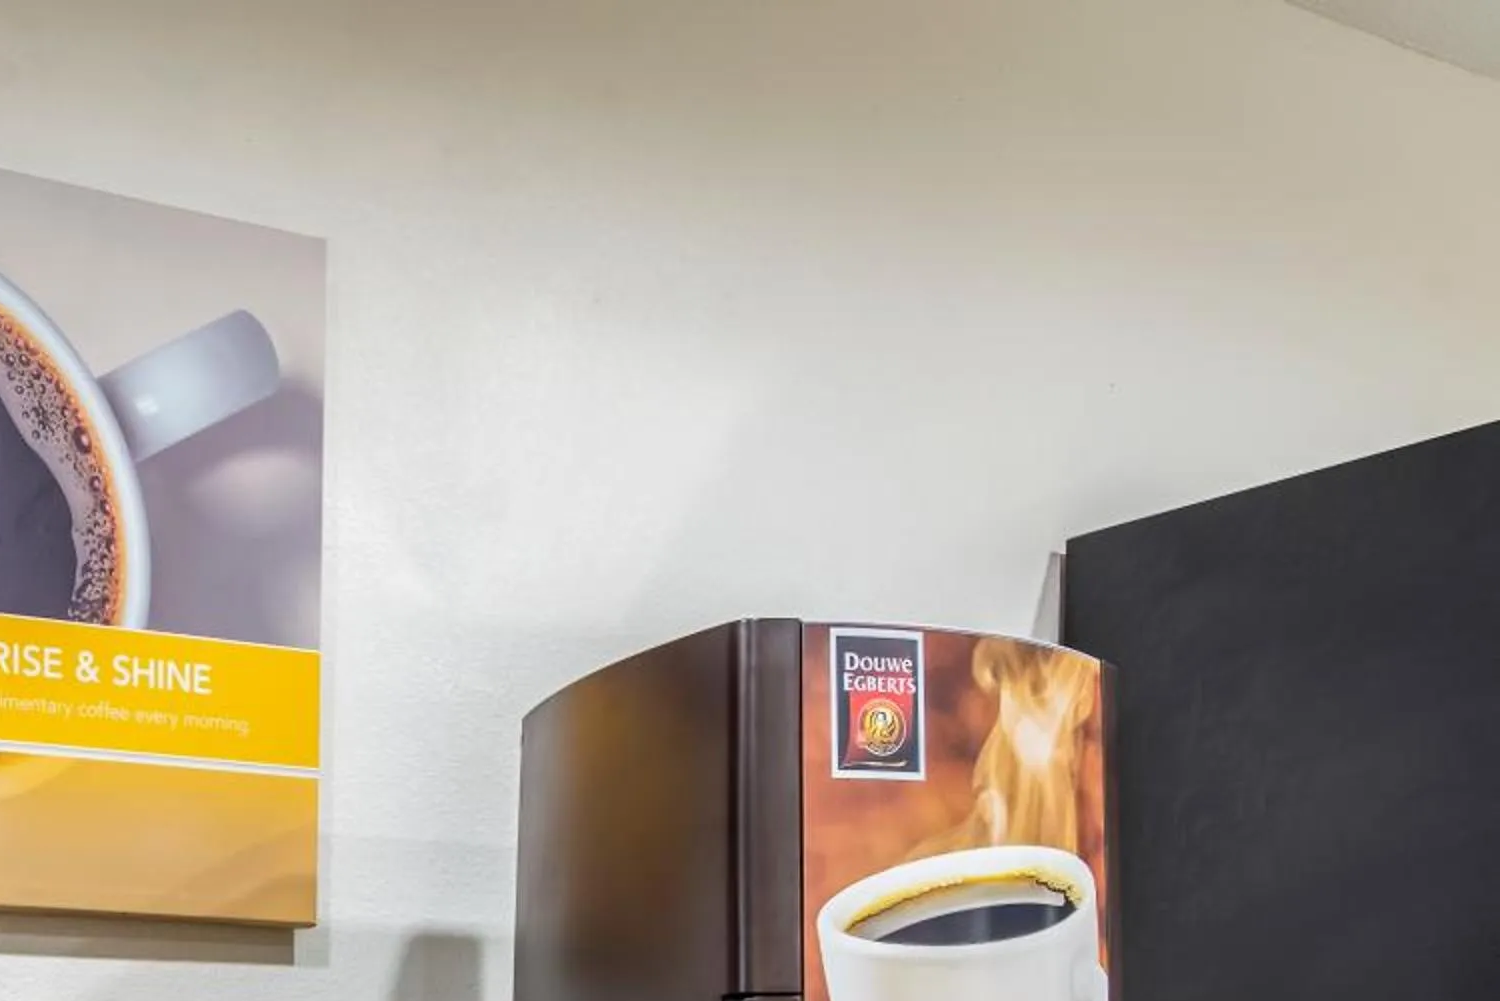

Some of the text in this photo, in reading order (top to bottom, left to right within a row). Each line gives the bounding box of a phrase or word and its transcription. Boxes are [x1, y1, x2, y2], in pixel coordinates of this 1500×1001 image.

[76, 650, 100, 684] &
[113, 655, 213, 695] SHINE
[843, 673, 916, 695] EGBERTS
[77, 700, 130, 722] coffee
[135, 708, 179, 730] every
[183, 714, 250, 737] morning
